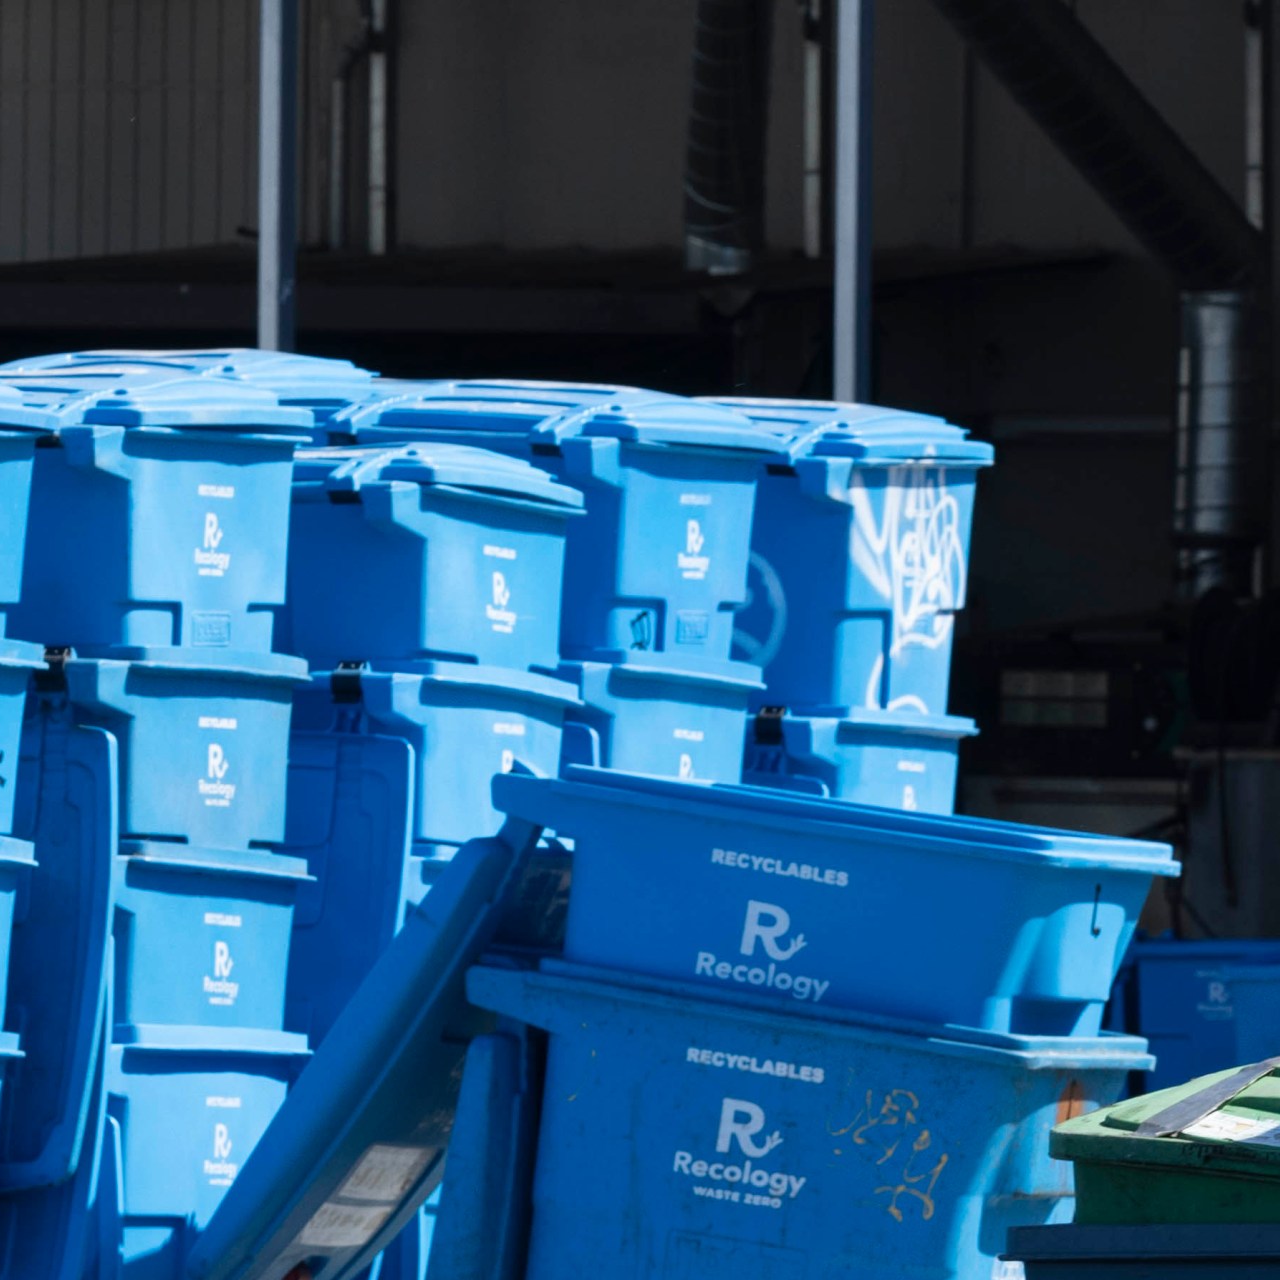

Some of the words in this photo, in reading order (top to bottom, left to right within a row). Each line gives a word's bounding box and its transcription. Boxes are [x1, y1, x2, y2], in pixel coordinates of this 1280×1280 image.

[712, 849, 848, 886] RECYCLABLES
[696, 950, 829, 1000] Recology
[687, 1048, 824, 1083] RECYCLABLES
[674, 1149, 805, 1198] Recology
[693, 1185, 740, 1204] WASTE
[744, 1191, 782, 1208] ZERO
